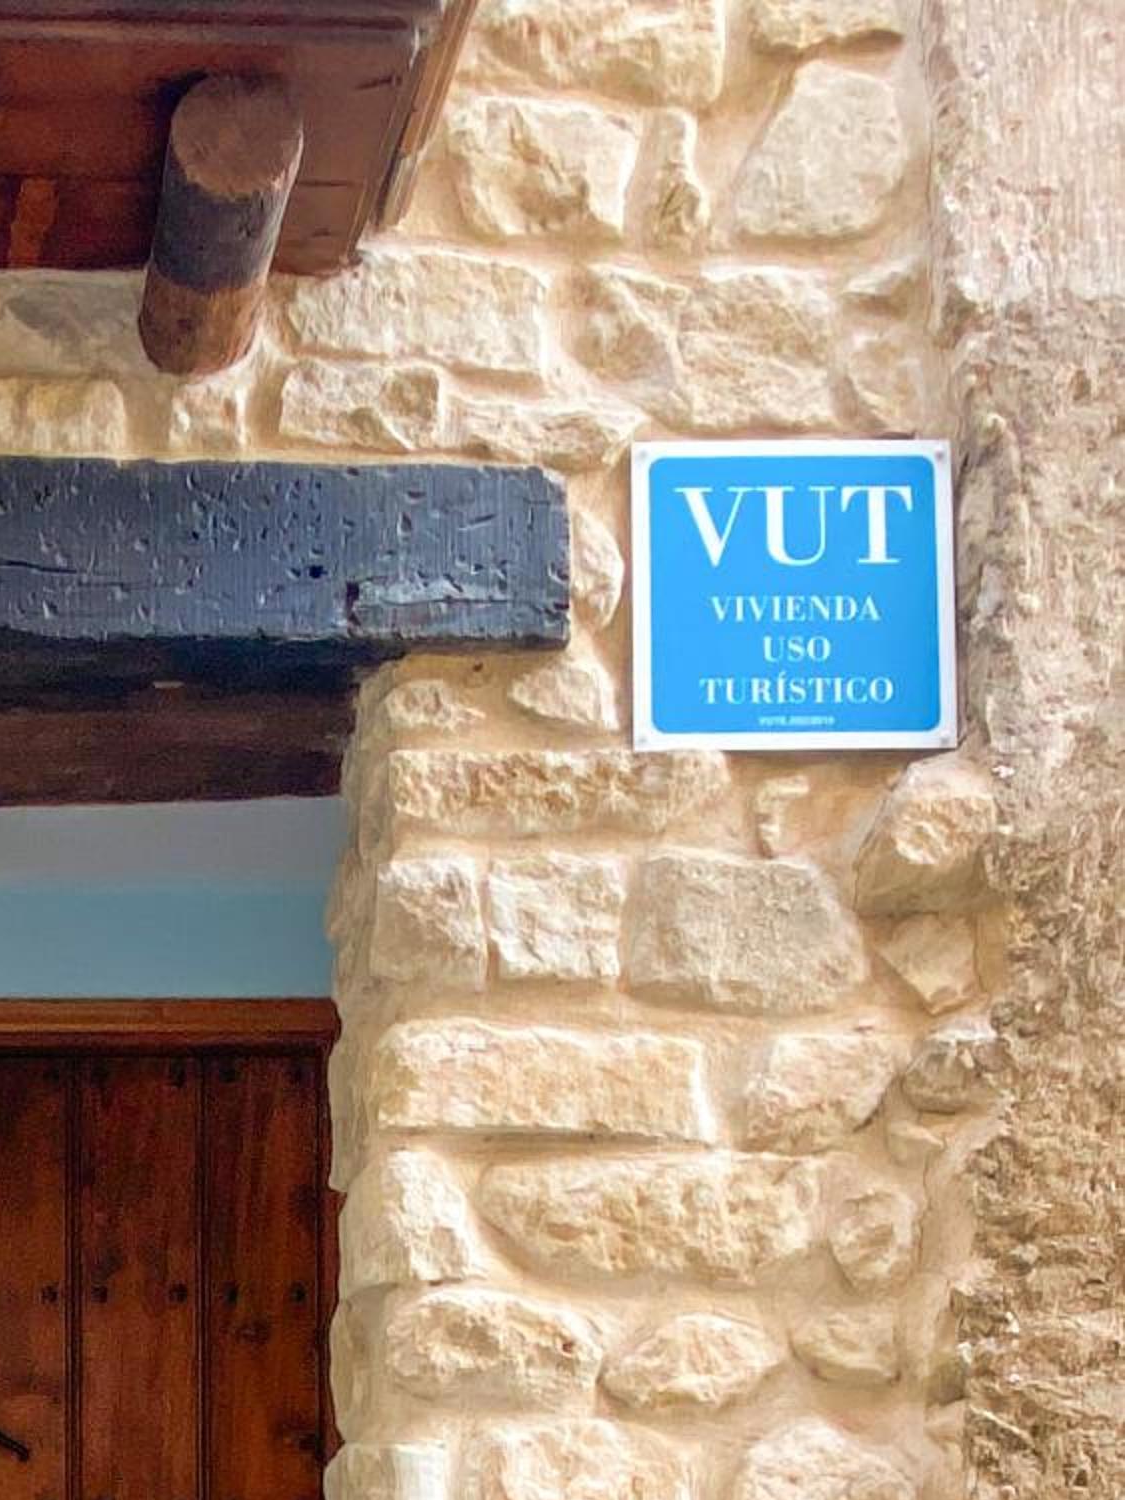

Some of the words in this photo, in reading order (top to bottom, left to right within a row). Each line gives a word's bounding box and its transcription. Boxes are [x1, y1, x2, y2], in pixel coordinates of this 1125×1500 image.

[673, 486, 913, 567] VUT
[709, 595, 882, 621] VIVIENDA
[763, 636, 831, 662] USO
[699, 671, 895, 705] TURÍSTICO
